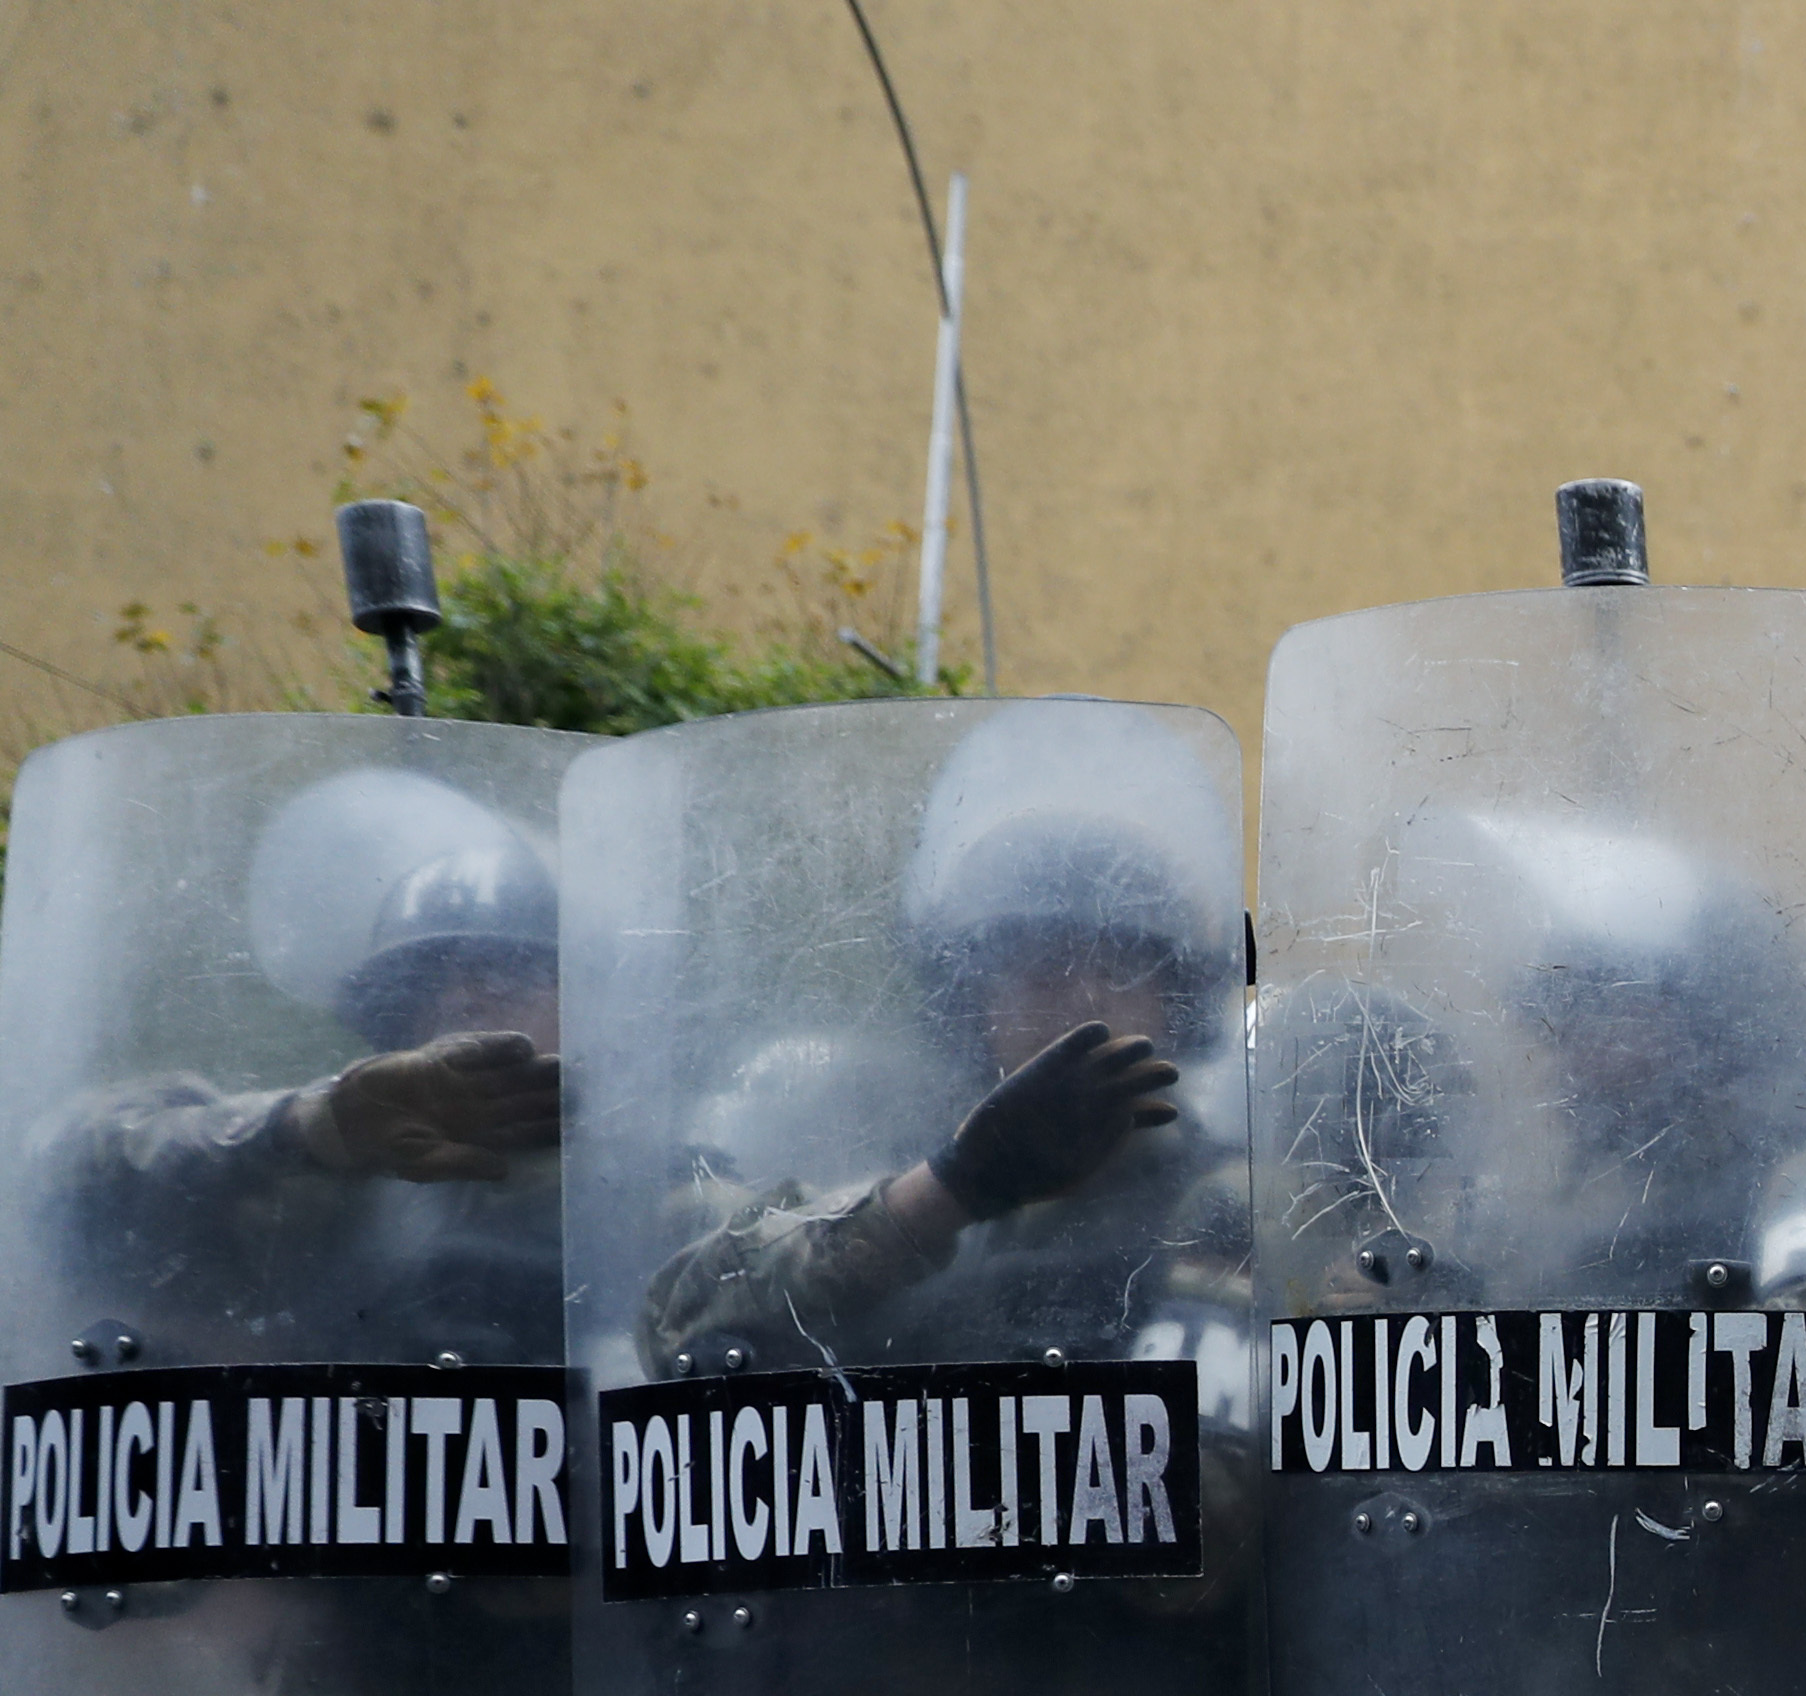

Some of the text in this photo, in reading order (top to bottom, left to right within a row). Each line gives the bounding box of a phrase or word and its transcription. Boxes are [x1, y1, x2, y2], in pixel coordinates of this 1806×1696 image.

[1272, 1315, 1510, 1473] POLICIA
[10, 1397, 567, 1560] POLICIA MILITAR
[612, 1394, 1176, 1569] POLICIA MILITAR
